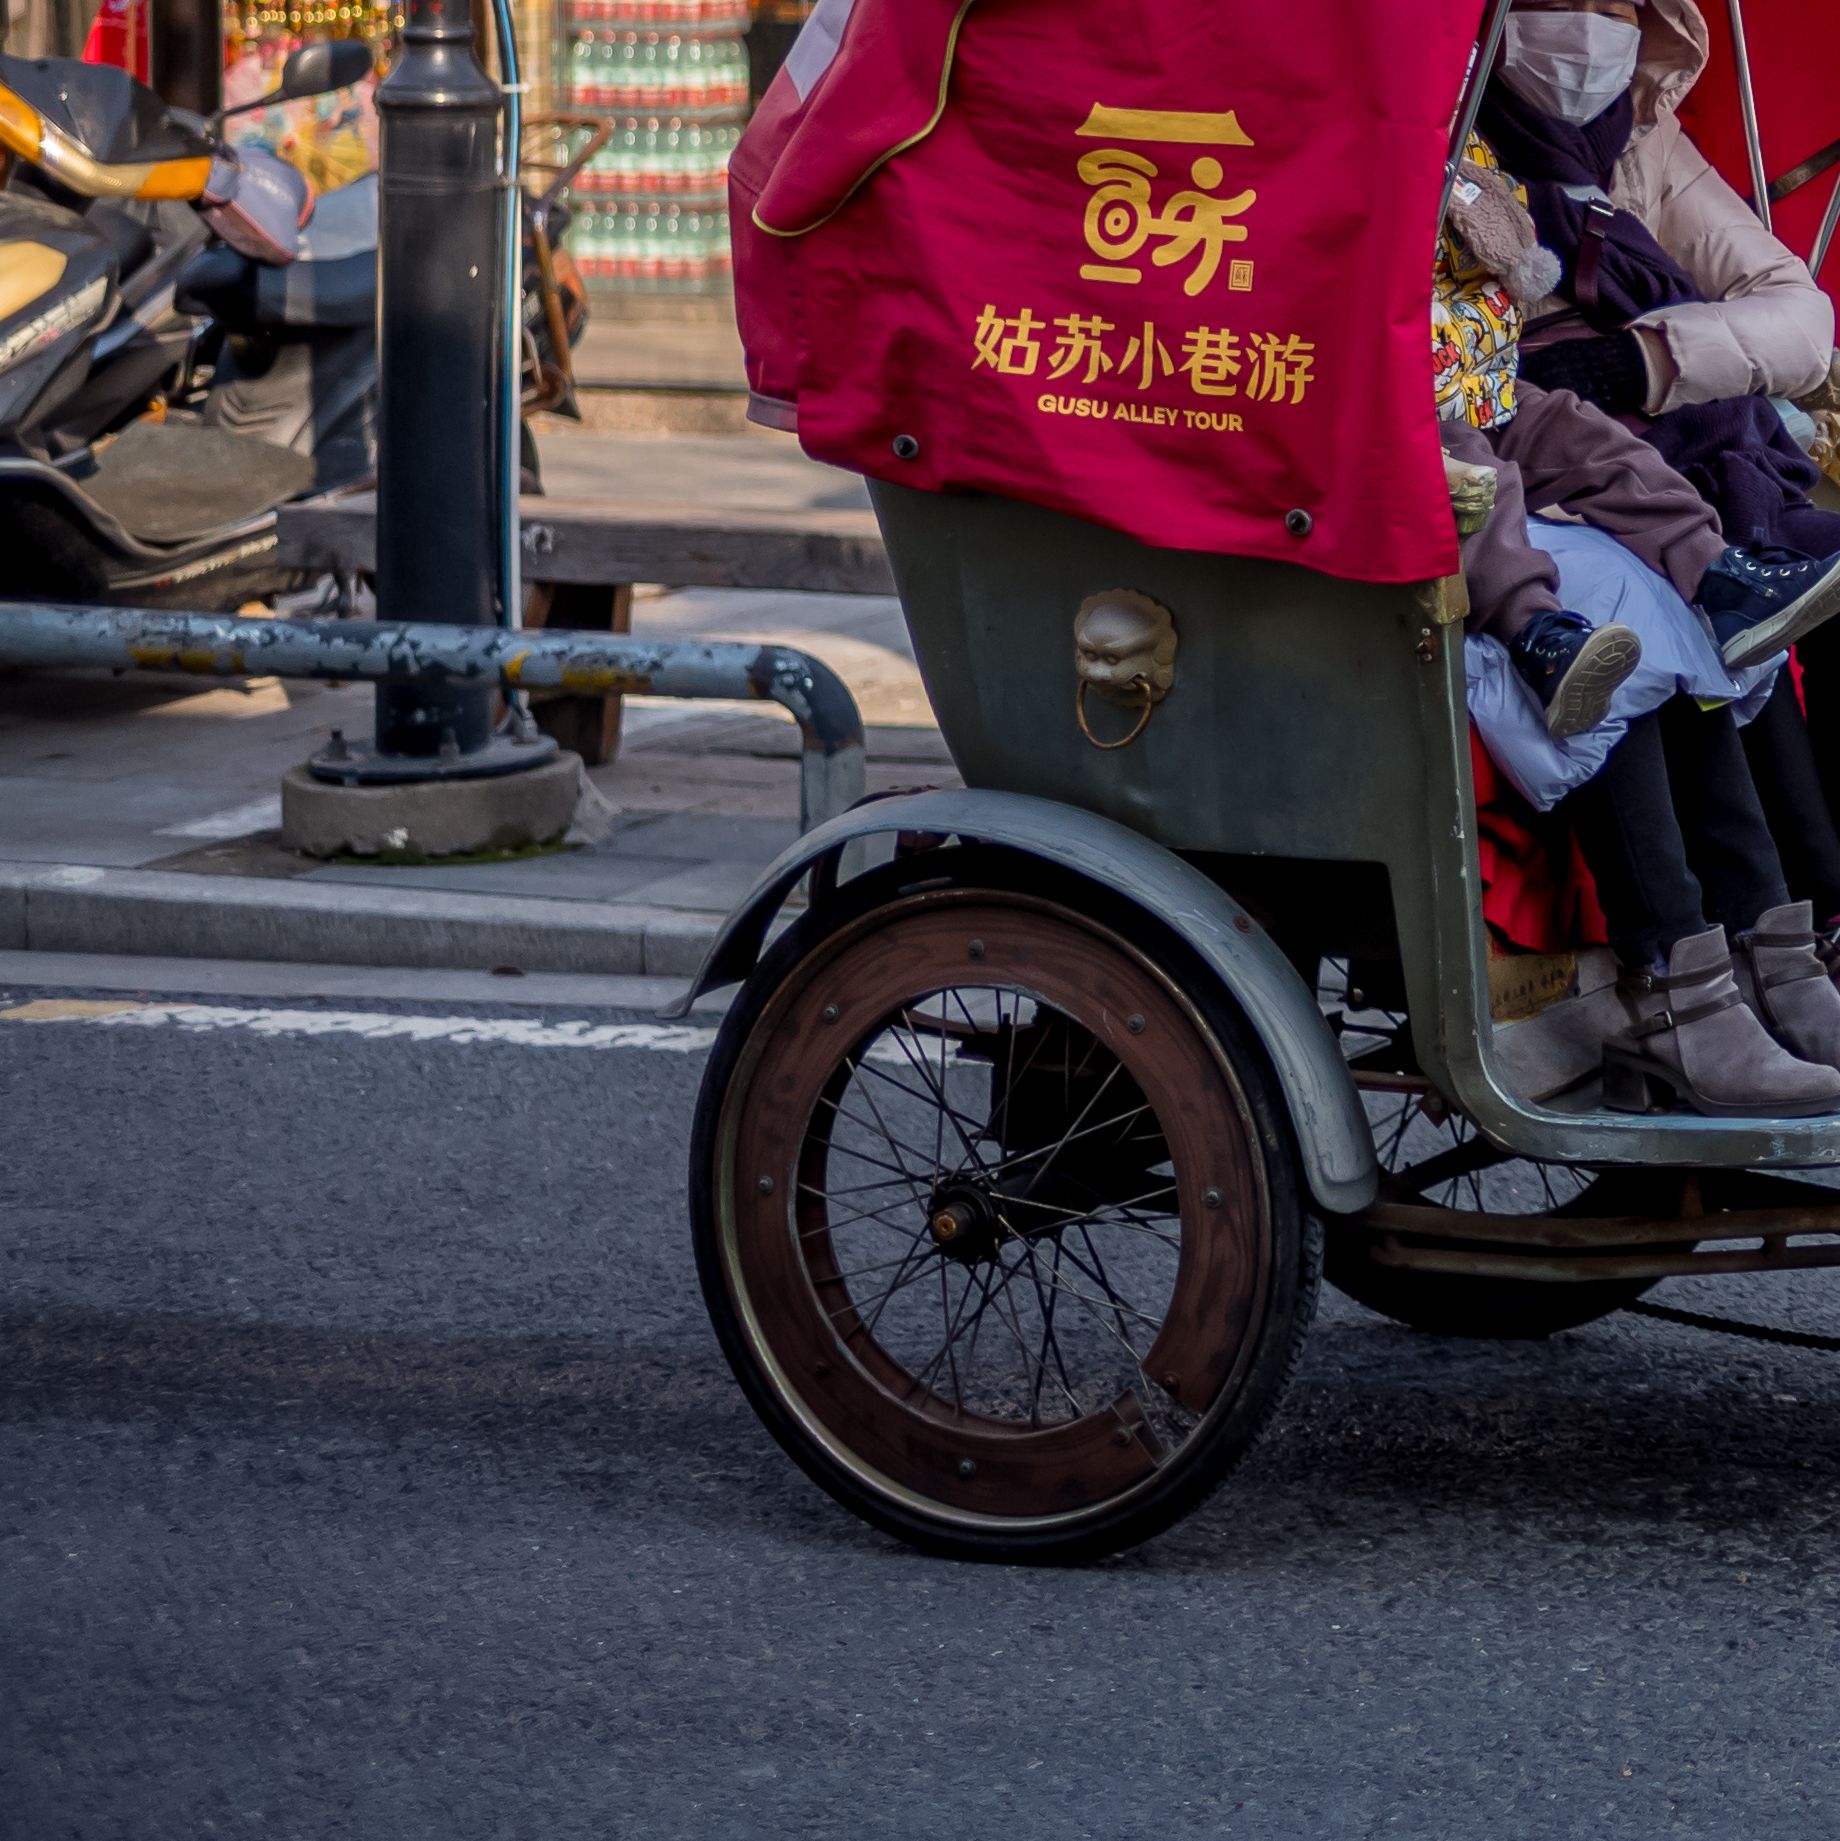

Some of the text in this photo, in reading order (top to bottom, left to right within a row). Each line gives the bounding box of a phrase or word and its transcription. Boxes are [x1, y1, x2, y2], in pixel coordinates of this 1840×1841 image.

[970, 304, 1315, 405] 姑苏小巷游
[1037, 393, 1244, 432] GUSU ALLEY TOUR
